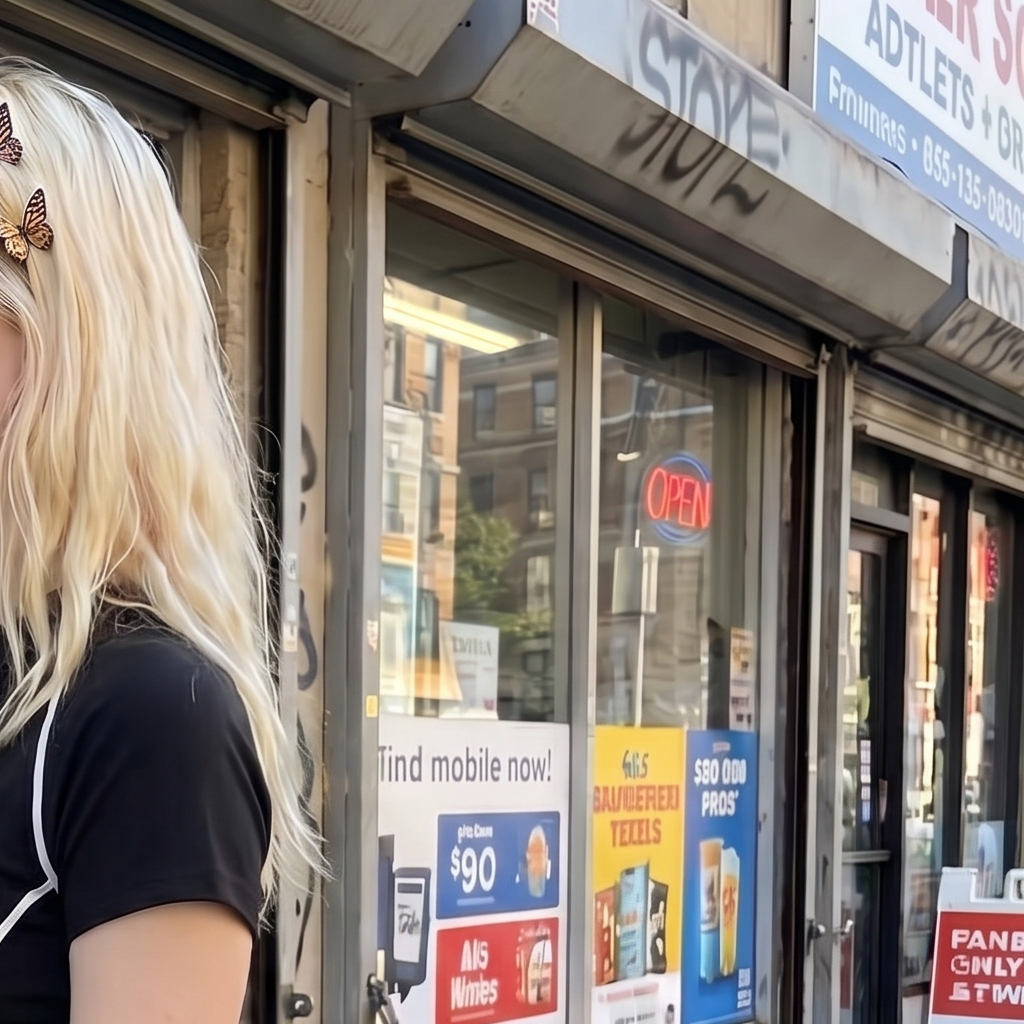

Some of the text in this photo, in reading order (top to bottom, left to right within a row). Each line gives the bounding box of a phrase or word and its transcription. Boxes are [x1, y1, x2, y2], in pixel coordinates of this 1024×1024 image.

[647, 467, 710, 529] OPEN
[431, 747, 502, 782] mobile
[508, 749, 552, 782] now!
[450, 845, 497, 893] $90
